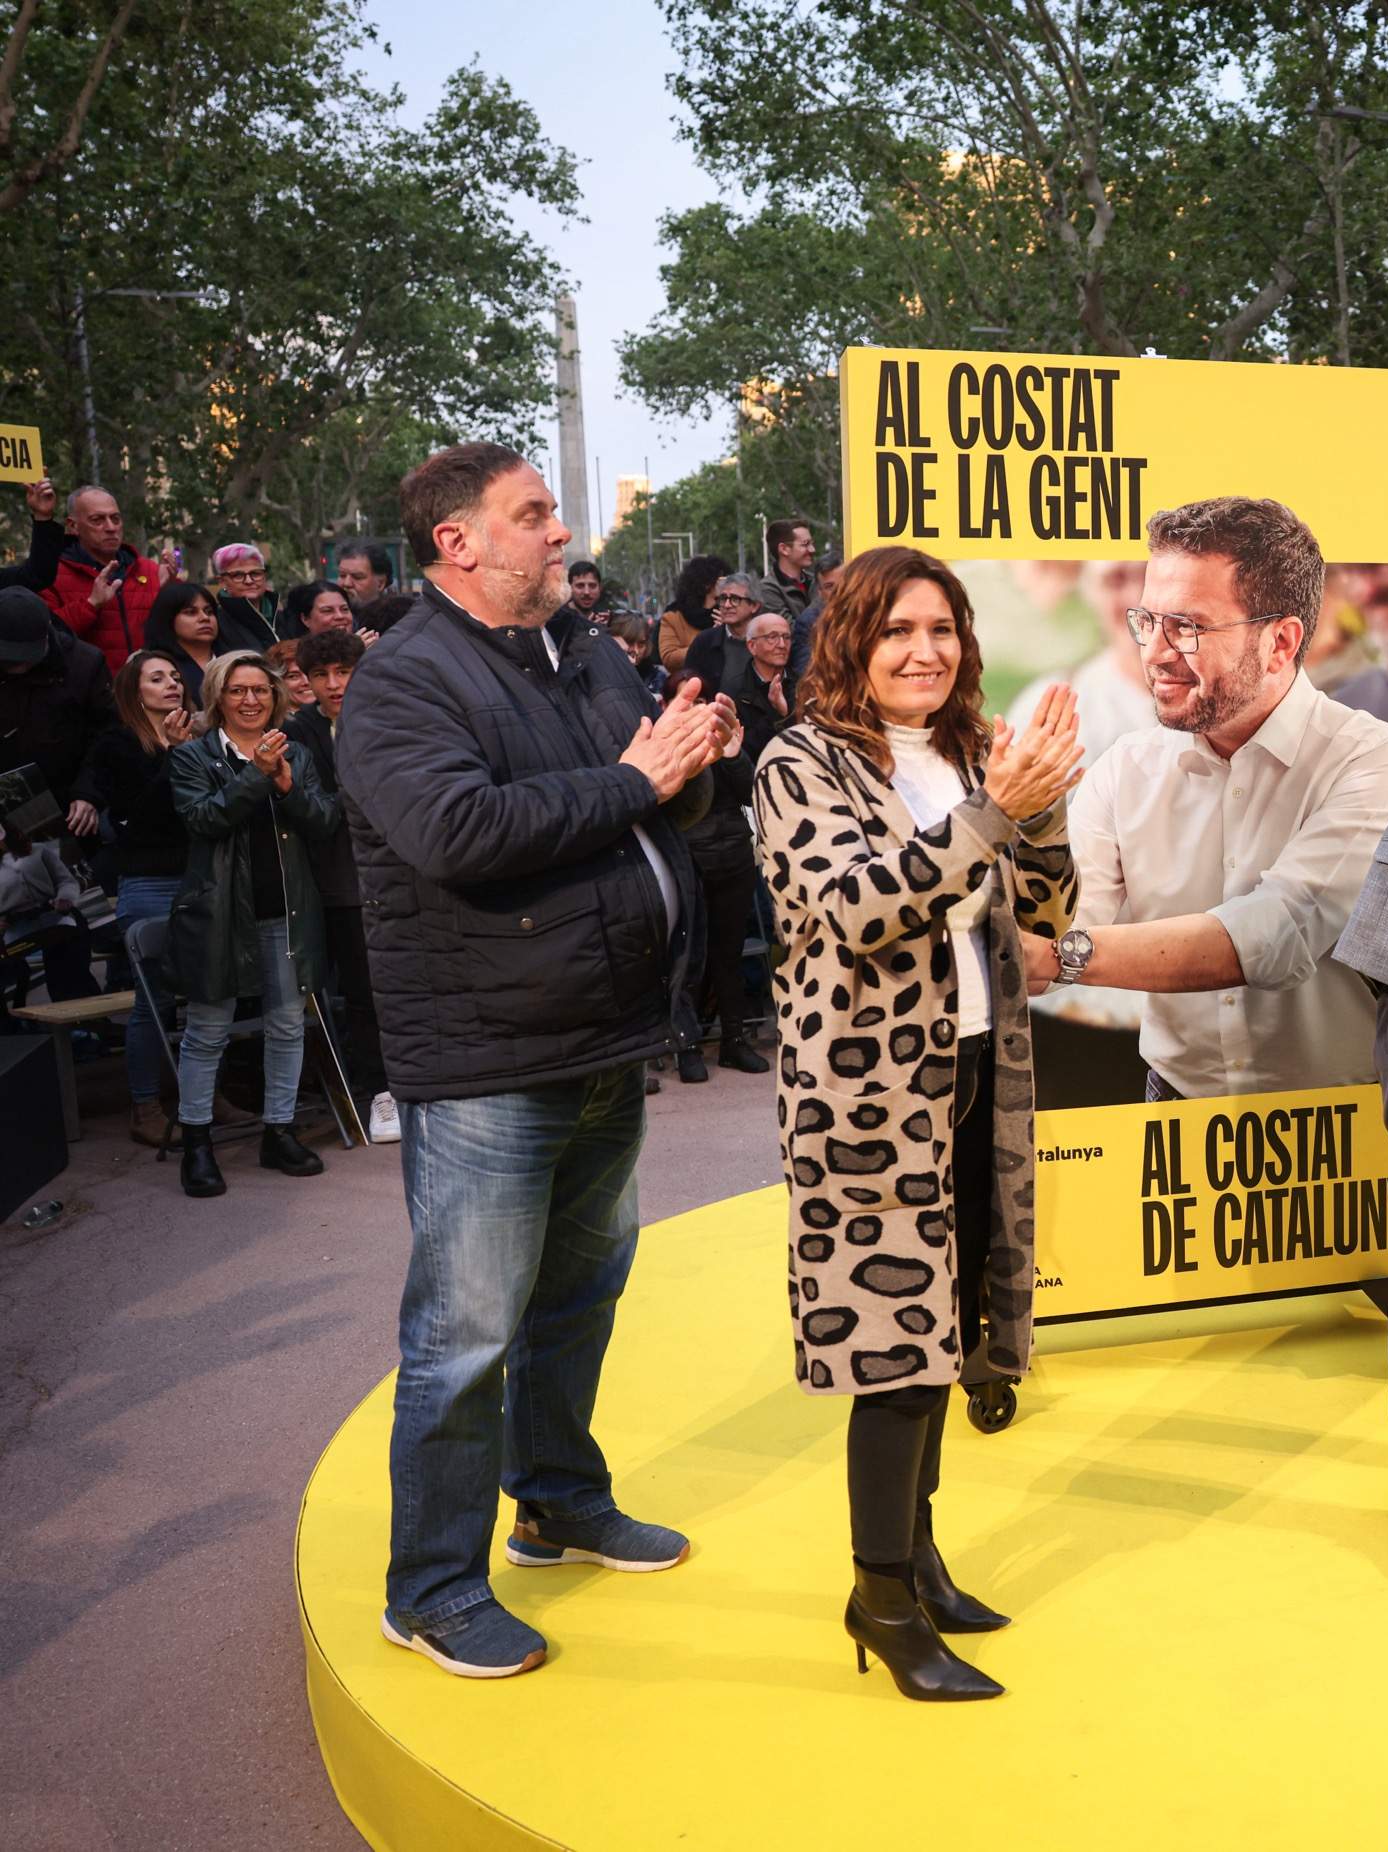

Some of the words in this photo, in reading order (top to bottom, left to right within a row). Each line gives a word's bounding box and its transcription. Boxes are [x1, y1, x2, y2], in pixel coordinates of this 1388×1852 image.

[875, 360, 931, 447] AL
[948, 363, 1120, 452] COSTAT
[0, 436, 32, 470] CIA
[876, 452, 939, 538] DE
[958, 454, 1012, 538] LA
[1029, 455, 1148, 540] GENT
[1036, 1146, 1104, 1162] talunya
[1141, 1119, 1191, 1197] AL
[1205, 1104, 1358, 1191] COSTAT
[1142, 1197, 1198, 1276] DE
